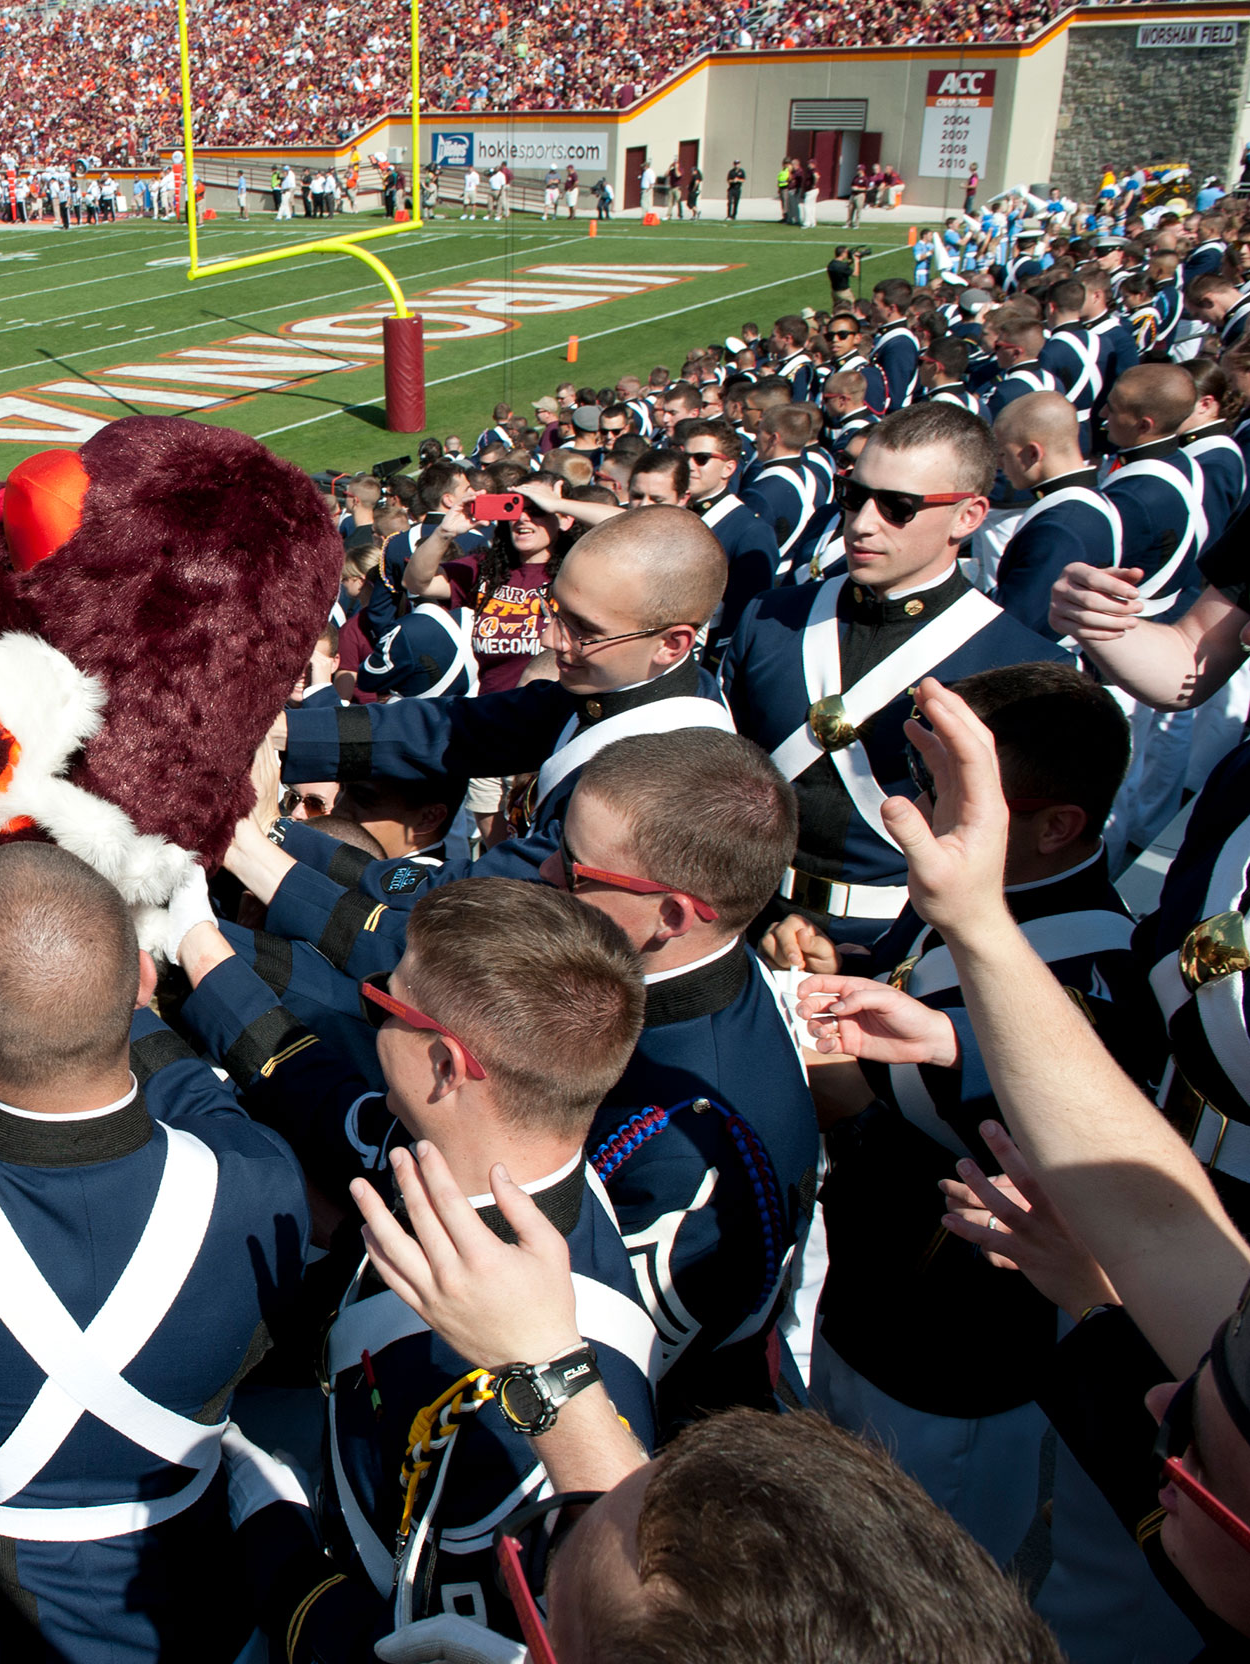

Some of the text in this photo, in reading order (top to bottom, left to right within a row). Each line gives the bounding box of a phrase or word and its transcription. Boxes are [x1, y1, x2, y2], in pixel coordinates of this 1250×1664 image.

[1140, 25, 1233, 45] WORSHAM FIELD
[937, 72, 986, 95] ACC
[943, 115, 970, 125] 2004
[941, 130, 969, 140] 2007
[478, 140, 600, 163] hokiesports.com
[940, 144, 967, 154] 2008
[938, 158, 966, 168] 2010
[472, 636, 547, 656] MECOMI
